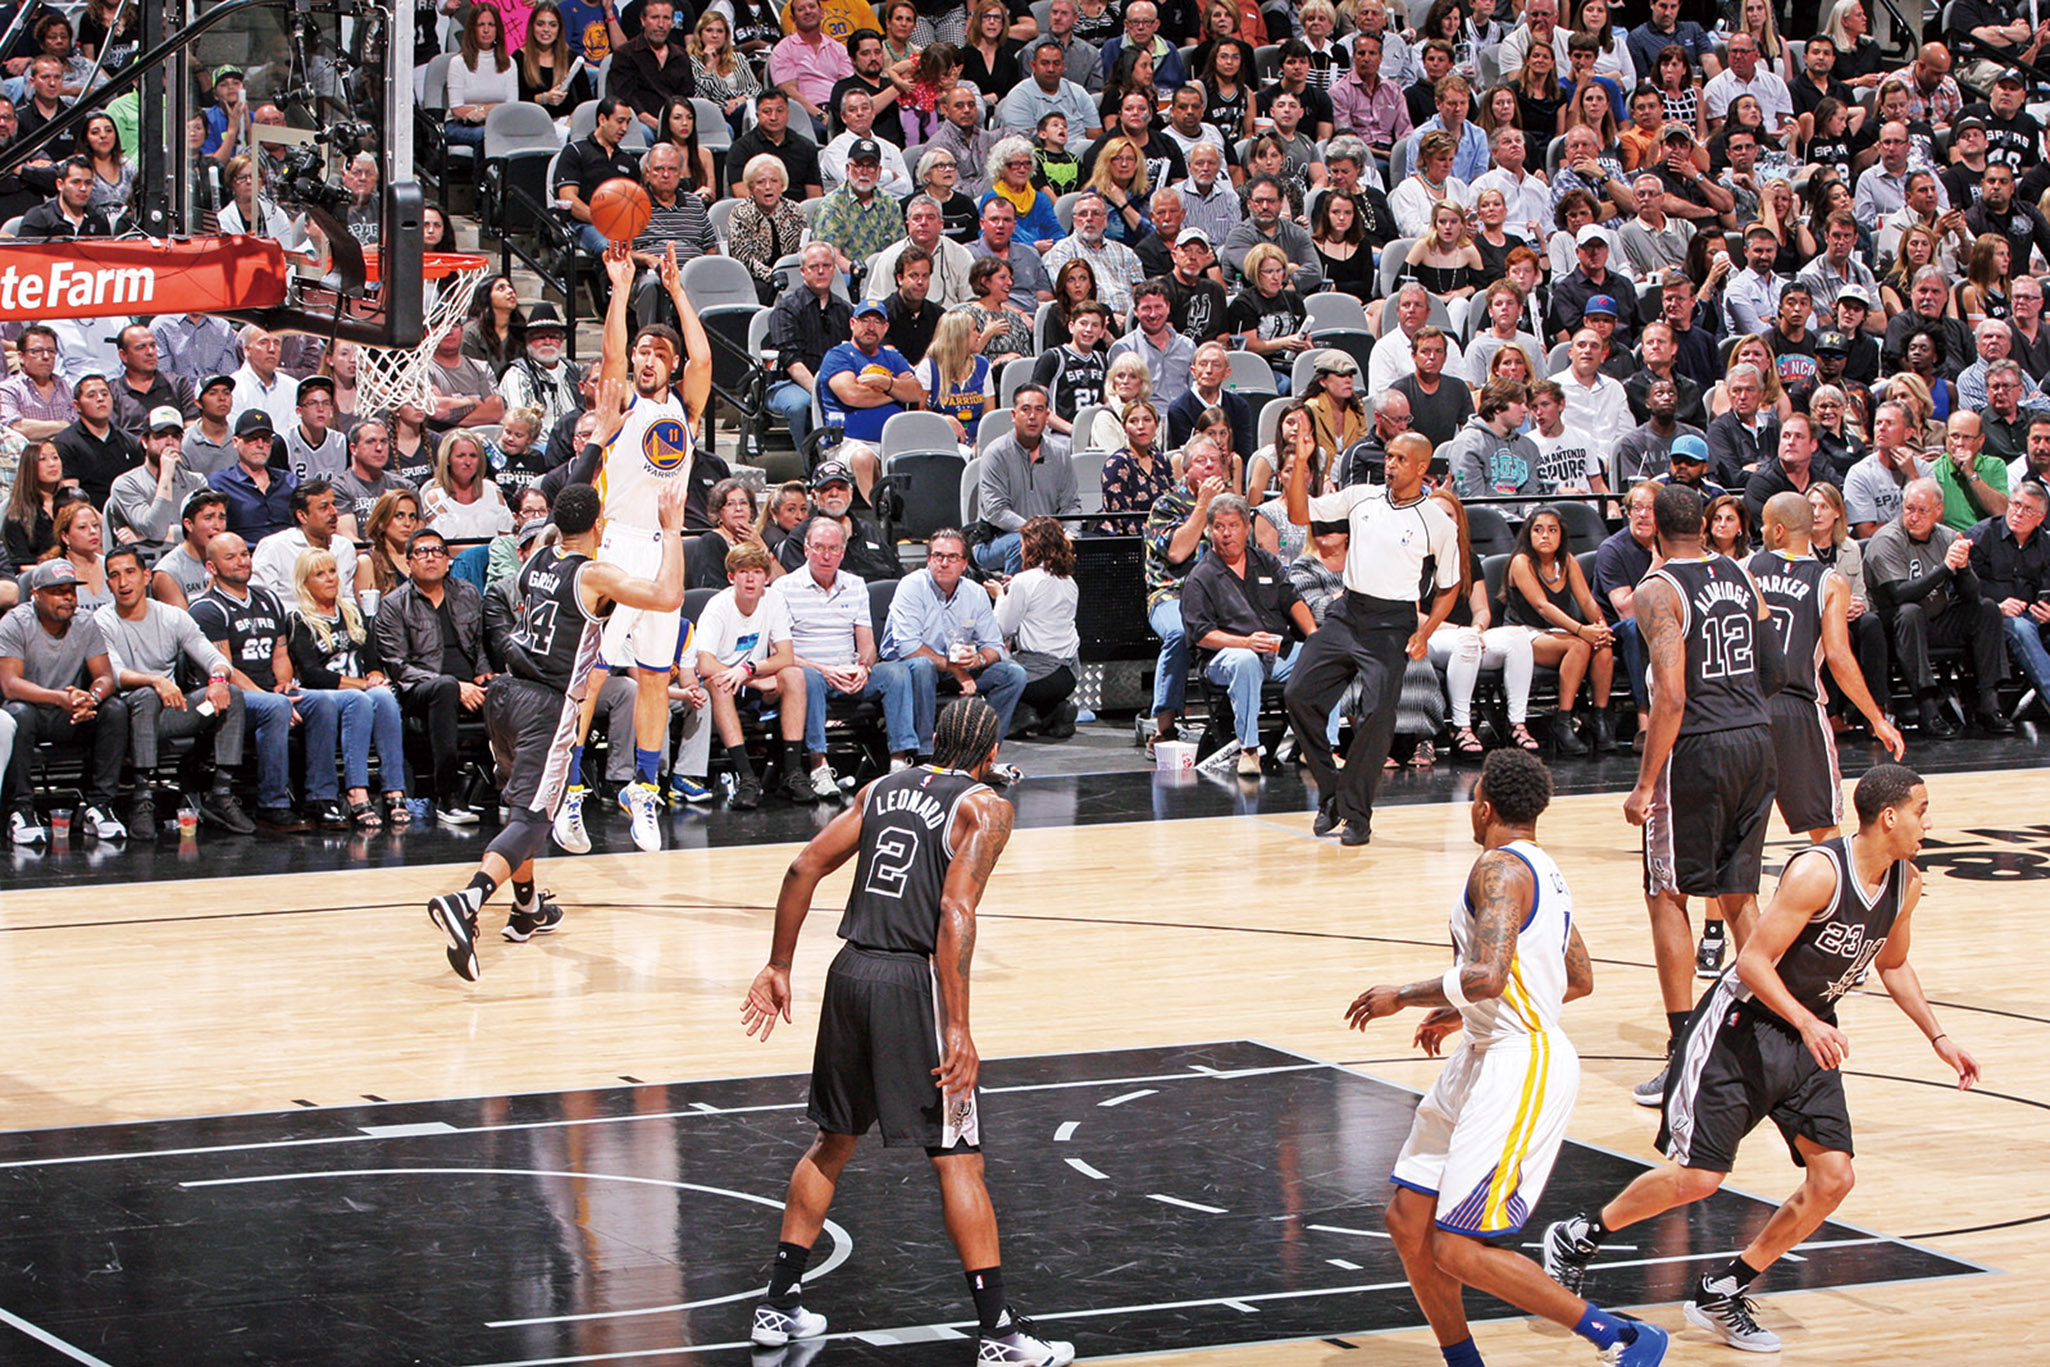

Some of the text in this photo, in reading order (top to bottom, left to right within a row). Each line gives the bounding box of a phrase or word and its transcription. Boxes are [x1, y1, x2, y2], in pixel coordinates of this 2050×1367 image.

[829, 22, 847, 35] 30
[669, 428, 679, 442] 11
[1537, 459, 1586, 481] SPURS
[1552, 448, 1586, 463] ANTONIO
[1694, 581, 1751, 616] ALDRIDGE
[509, 594, 559, 656] 14
[1702, 612, 1754, 678] 12
[876, 789, 946, 830] LEONARD
[865, 826, 919, 899] 2
[1814, 921, 1865, 958] 23
